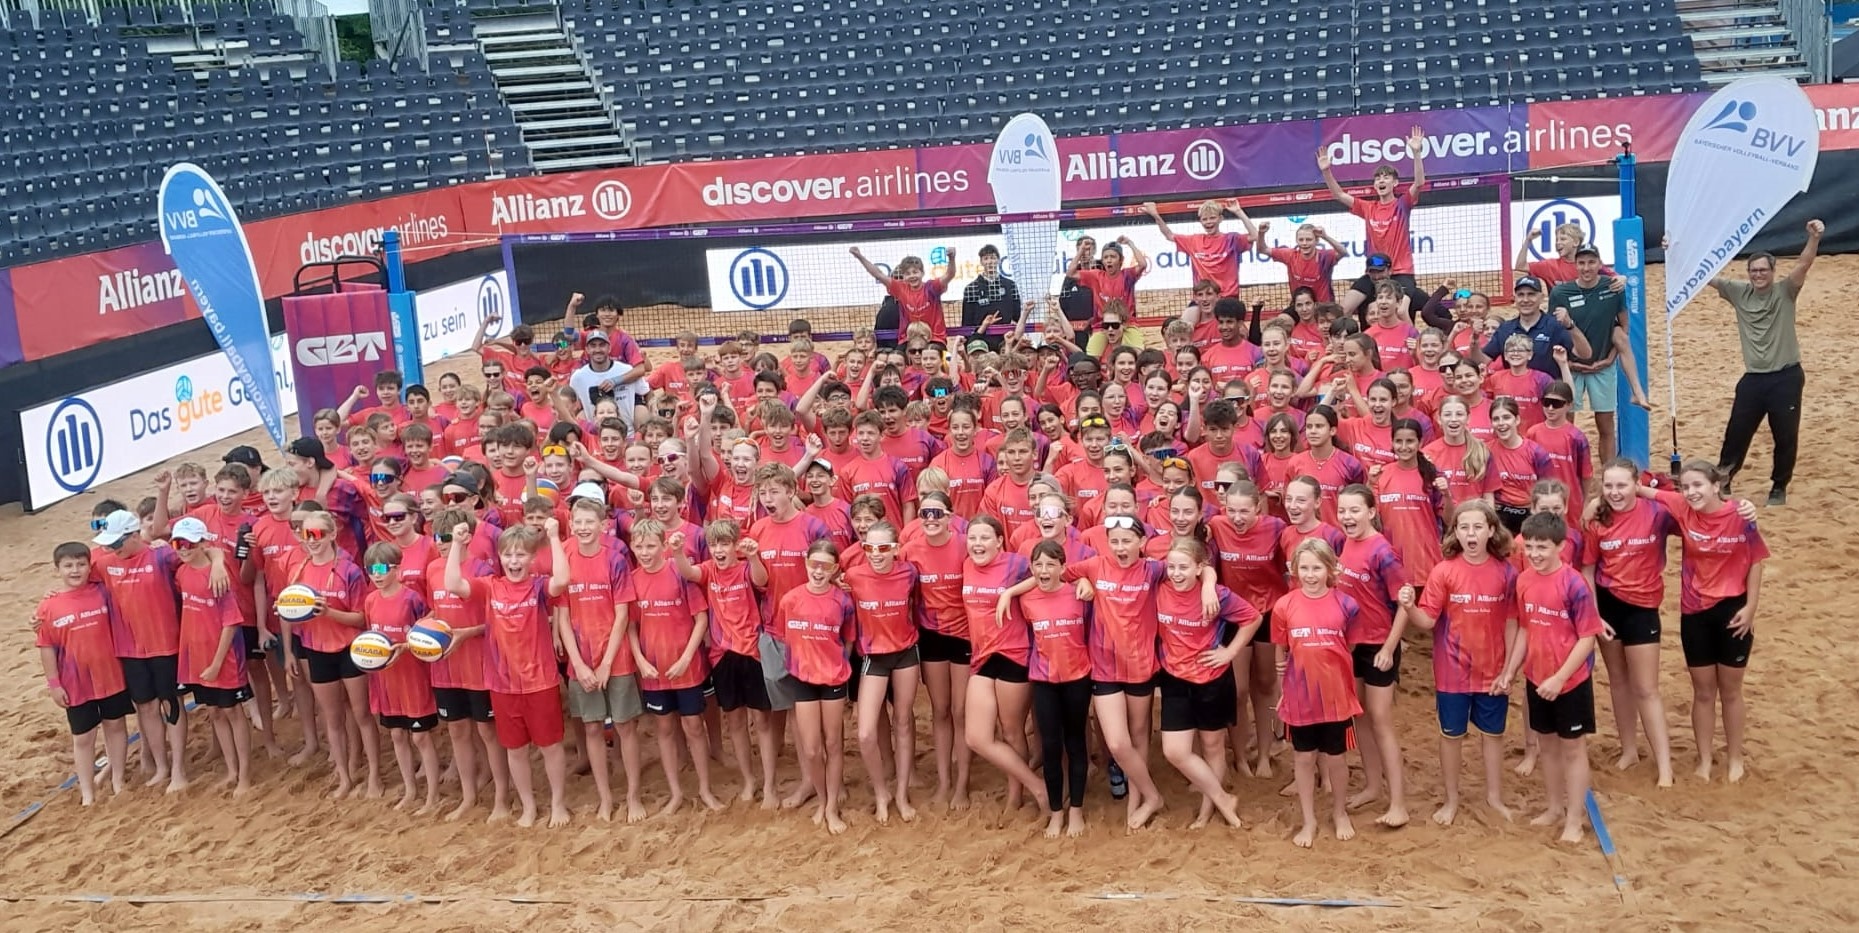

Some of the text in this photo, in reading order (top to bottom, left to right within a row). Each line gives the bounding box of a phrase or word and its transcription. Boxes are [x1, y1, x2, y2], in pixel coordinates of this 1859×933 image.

[1750, 128, 1806, 157] BVV
[1066, 147, 1176, 182] Allianz
[702, 166, 969, 207] discover.airlines
[491, 189, 586, 226] Allianz
[99, 268, 186, 314] Allianz
[423, 308, 467, 341] zu sein
[296, 331, 387, 367] GBT
[130, 388, 223, 441] Das gute
[1503, 506, 1527, 515] PRO
